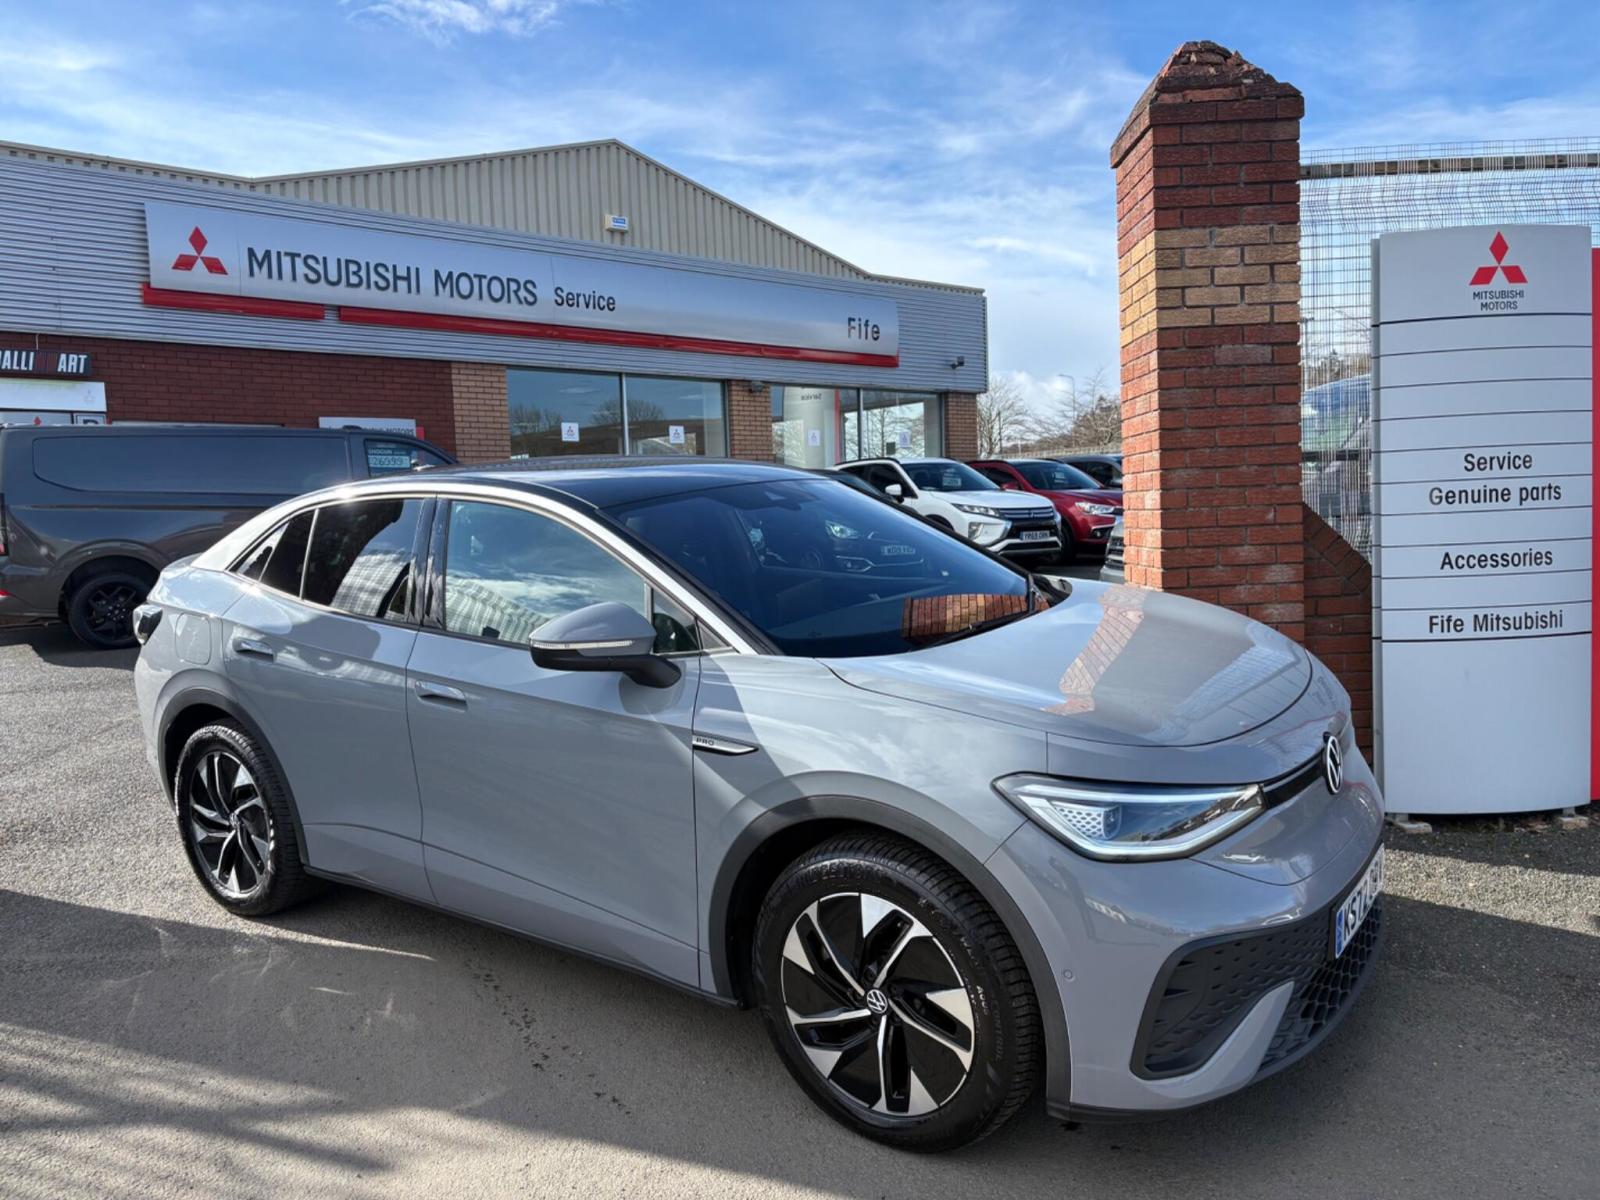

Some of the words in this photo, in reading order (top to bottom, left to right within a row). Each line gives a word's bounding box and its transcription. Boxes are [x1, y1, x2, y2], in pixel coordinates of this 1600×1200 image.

[247, 246, 420, 295] MITSUBISHI
[434, 268, 538, 306] MOTORS
[554, 286, 616, 312] Service
[847, 316, 881, 341] Fife
[1472, 289, 1525, 300] MITSUBISHI
[1480, 300, 1518, 311] MOTORS
[0, 350, 35, 371] ALLI
[57, 353, 88, 373] ART
[1463, 451, 1533, 472] Service
[1429, 485, 1511, 506] Genuine
[1519, 483, 1562, 506] parts
[1440, 548, 1553, 570] Accessories
[1429, 615, 1464, 634] Fife
[1473, 610, 1563, 633] Mitsubishi
[696, 737, 714, 746] PRO
